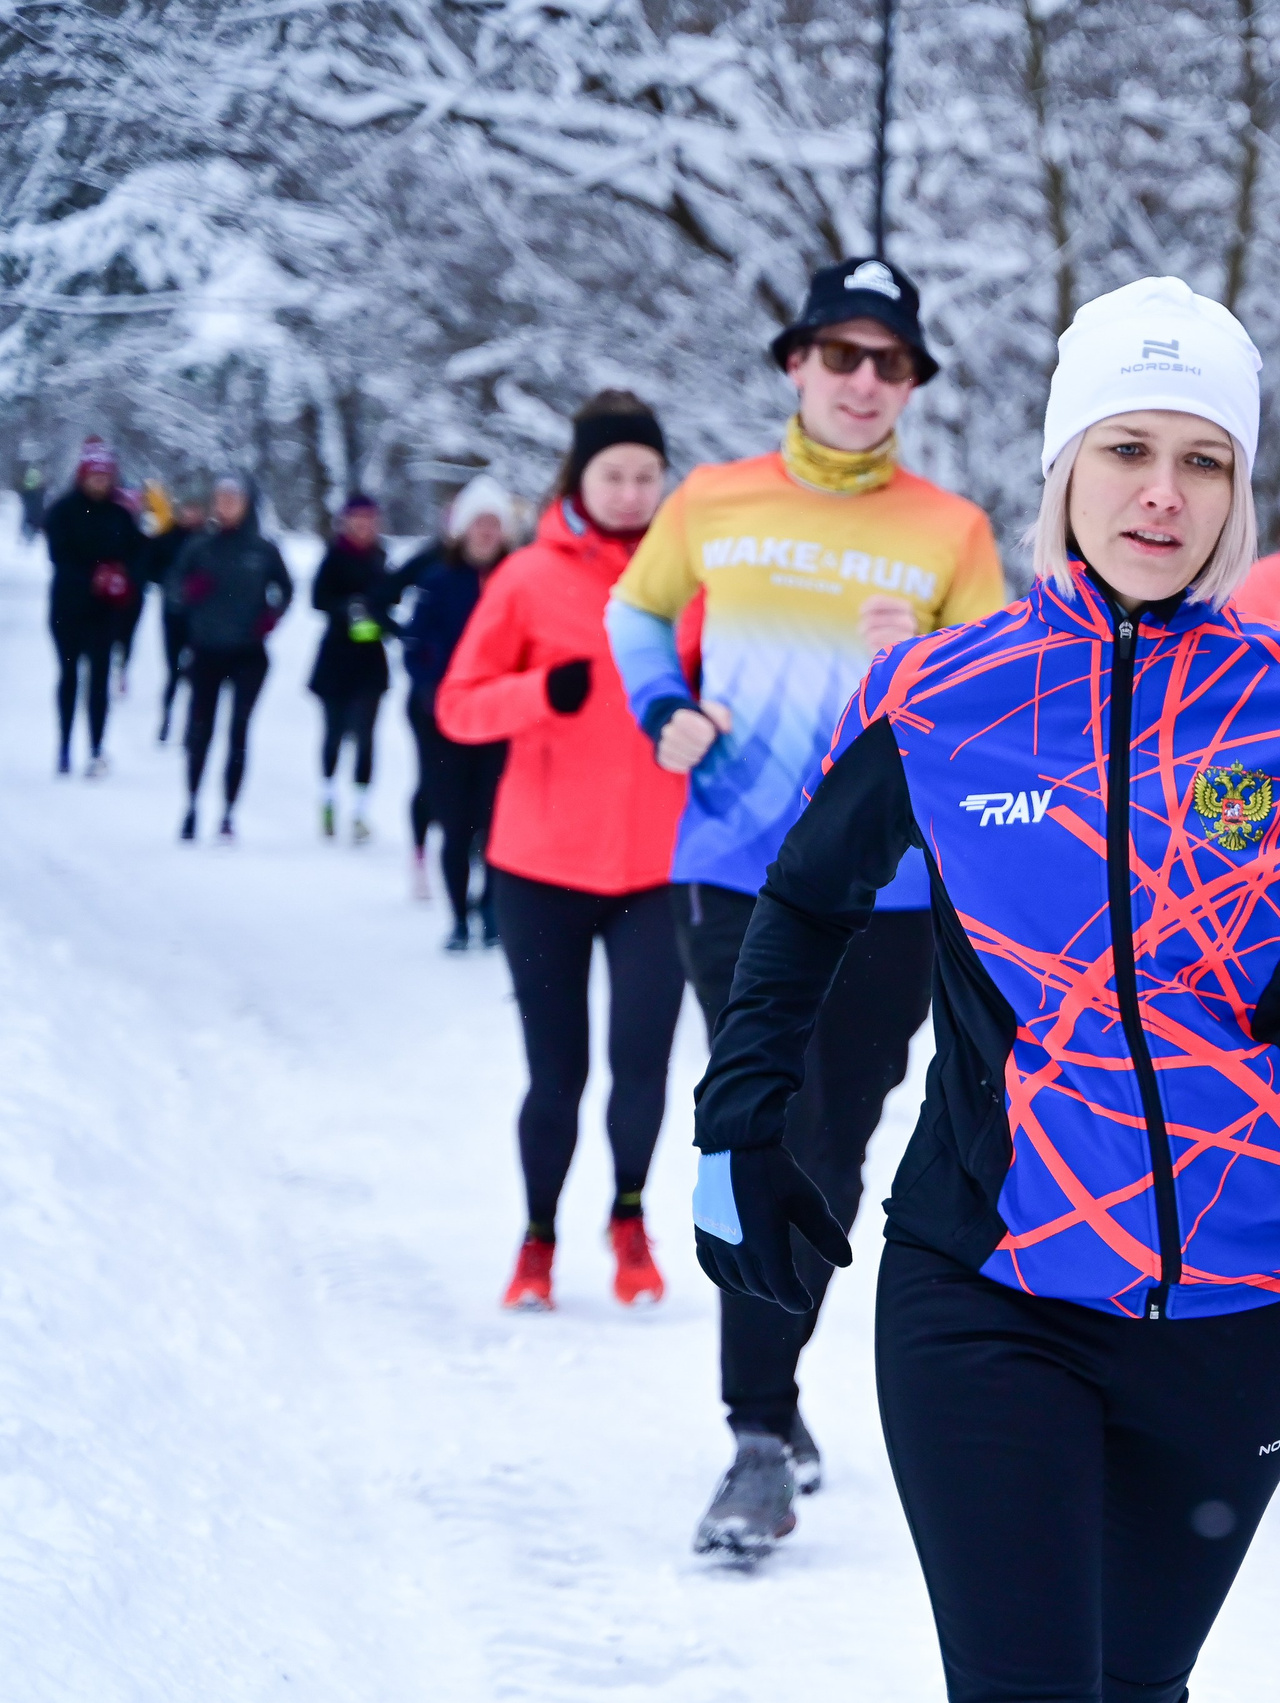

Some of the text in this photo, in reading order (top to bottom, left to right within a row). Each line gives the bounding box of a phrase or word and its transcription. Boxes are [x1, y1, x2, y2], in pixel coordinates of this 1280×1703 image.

[1120, 362, 1202, 376] NORDSKI
[702, 536, 821, 573] WAKE
[839, 549, 937, 601] RUN
[959, 789, 1052, 827] RAY
